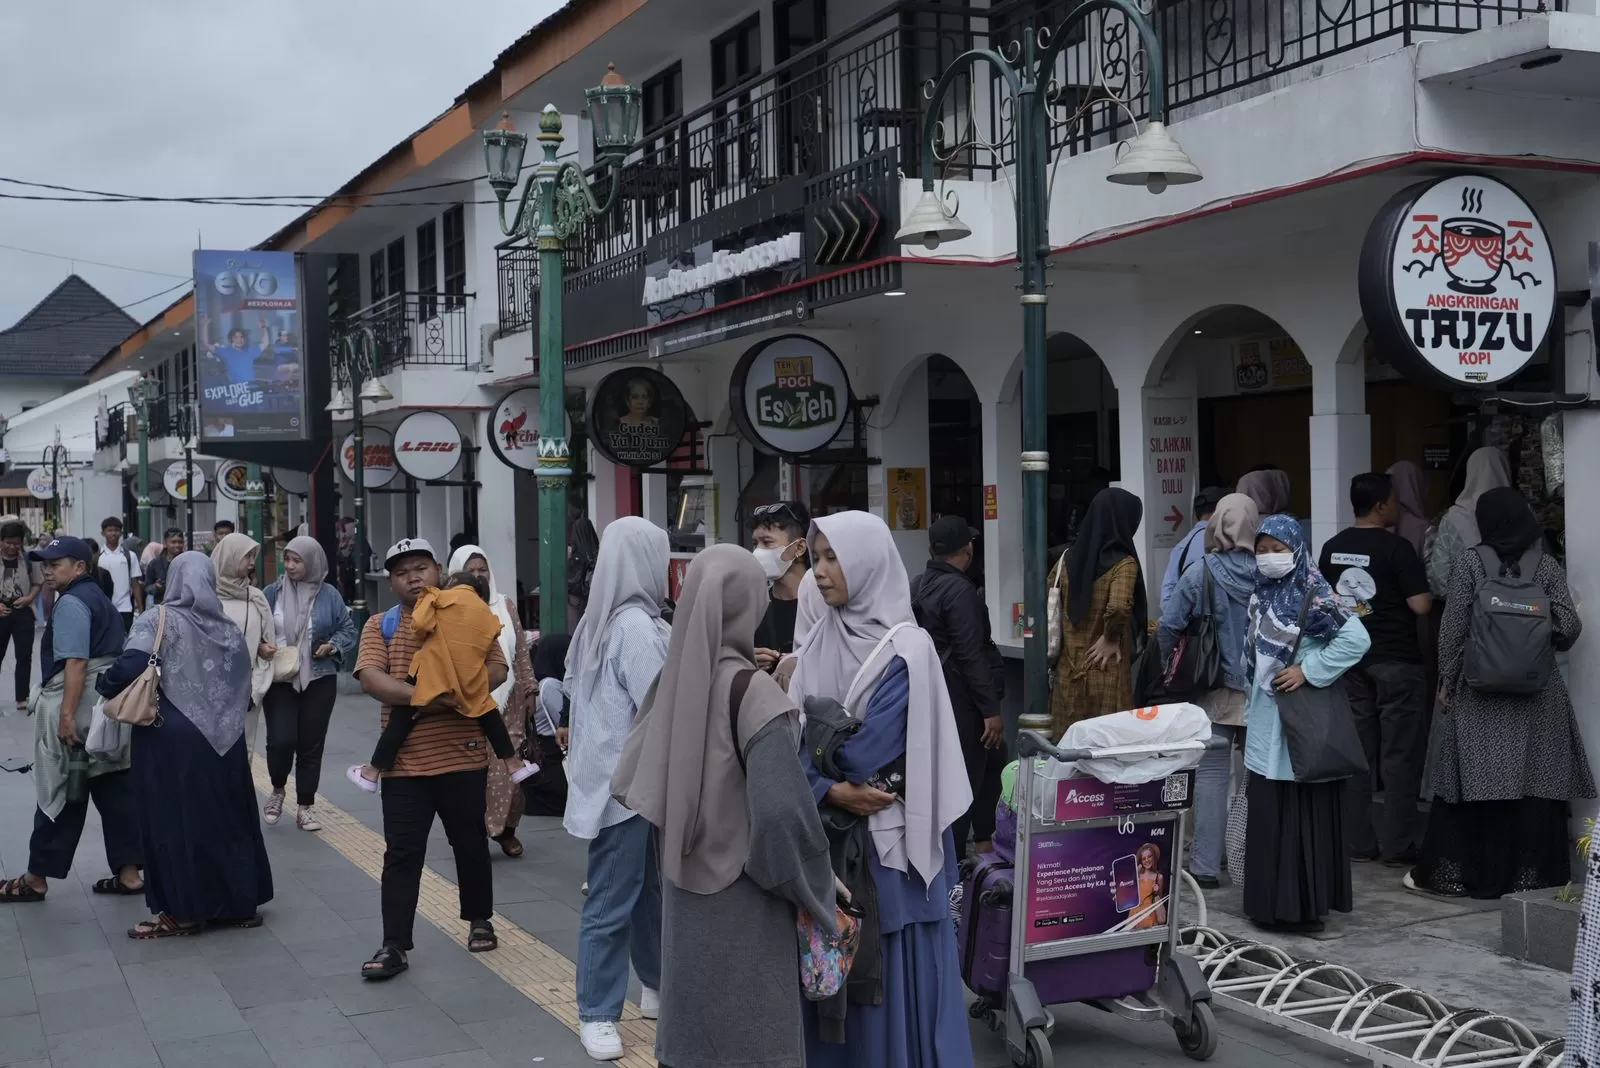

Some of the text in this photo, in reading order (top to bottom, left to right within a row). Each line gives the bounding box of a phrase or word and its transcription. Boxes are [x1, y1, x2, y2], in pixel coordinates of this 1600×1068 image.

[1426, 294, 1519, 310] ANGKRINGAN
[1405, 308, 1533, 352] TAJZU
[776, 361, 791, 369] TEH
[1458, 352, 1491, 365] KOPI
[778, 375, 811, 388] POCI
[204, 382, 250, 400] EXPLORE
[239, 391, 264, 407] GUE
[760, 390, 834, 423] Es Teh
[619, 422, 660, 437] Gudeg
[609, 433, 671, 451] Yu Djum
[1150, 437, 1192, 453] SILAHKAN
[1156, 458, 1186, 473] BAYAR
[1162, 479, 1183, 494] DULU
[1065, 789, 1105, 804] Access
[1150, 828, 1166, 836] KAI
[1037, 861, 1061, 870] Nikmati
[1037, 865, 1105, 878] Experience Perjalanan
[1037, 878, 1053, 886] Yang
[1053, 876, 1067, 884] Seru
[1081, 873, 1097, 881] Asyik
[1036, 886, 1064, 894] Bersama
[1064, 882, 1086, 890] Access
